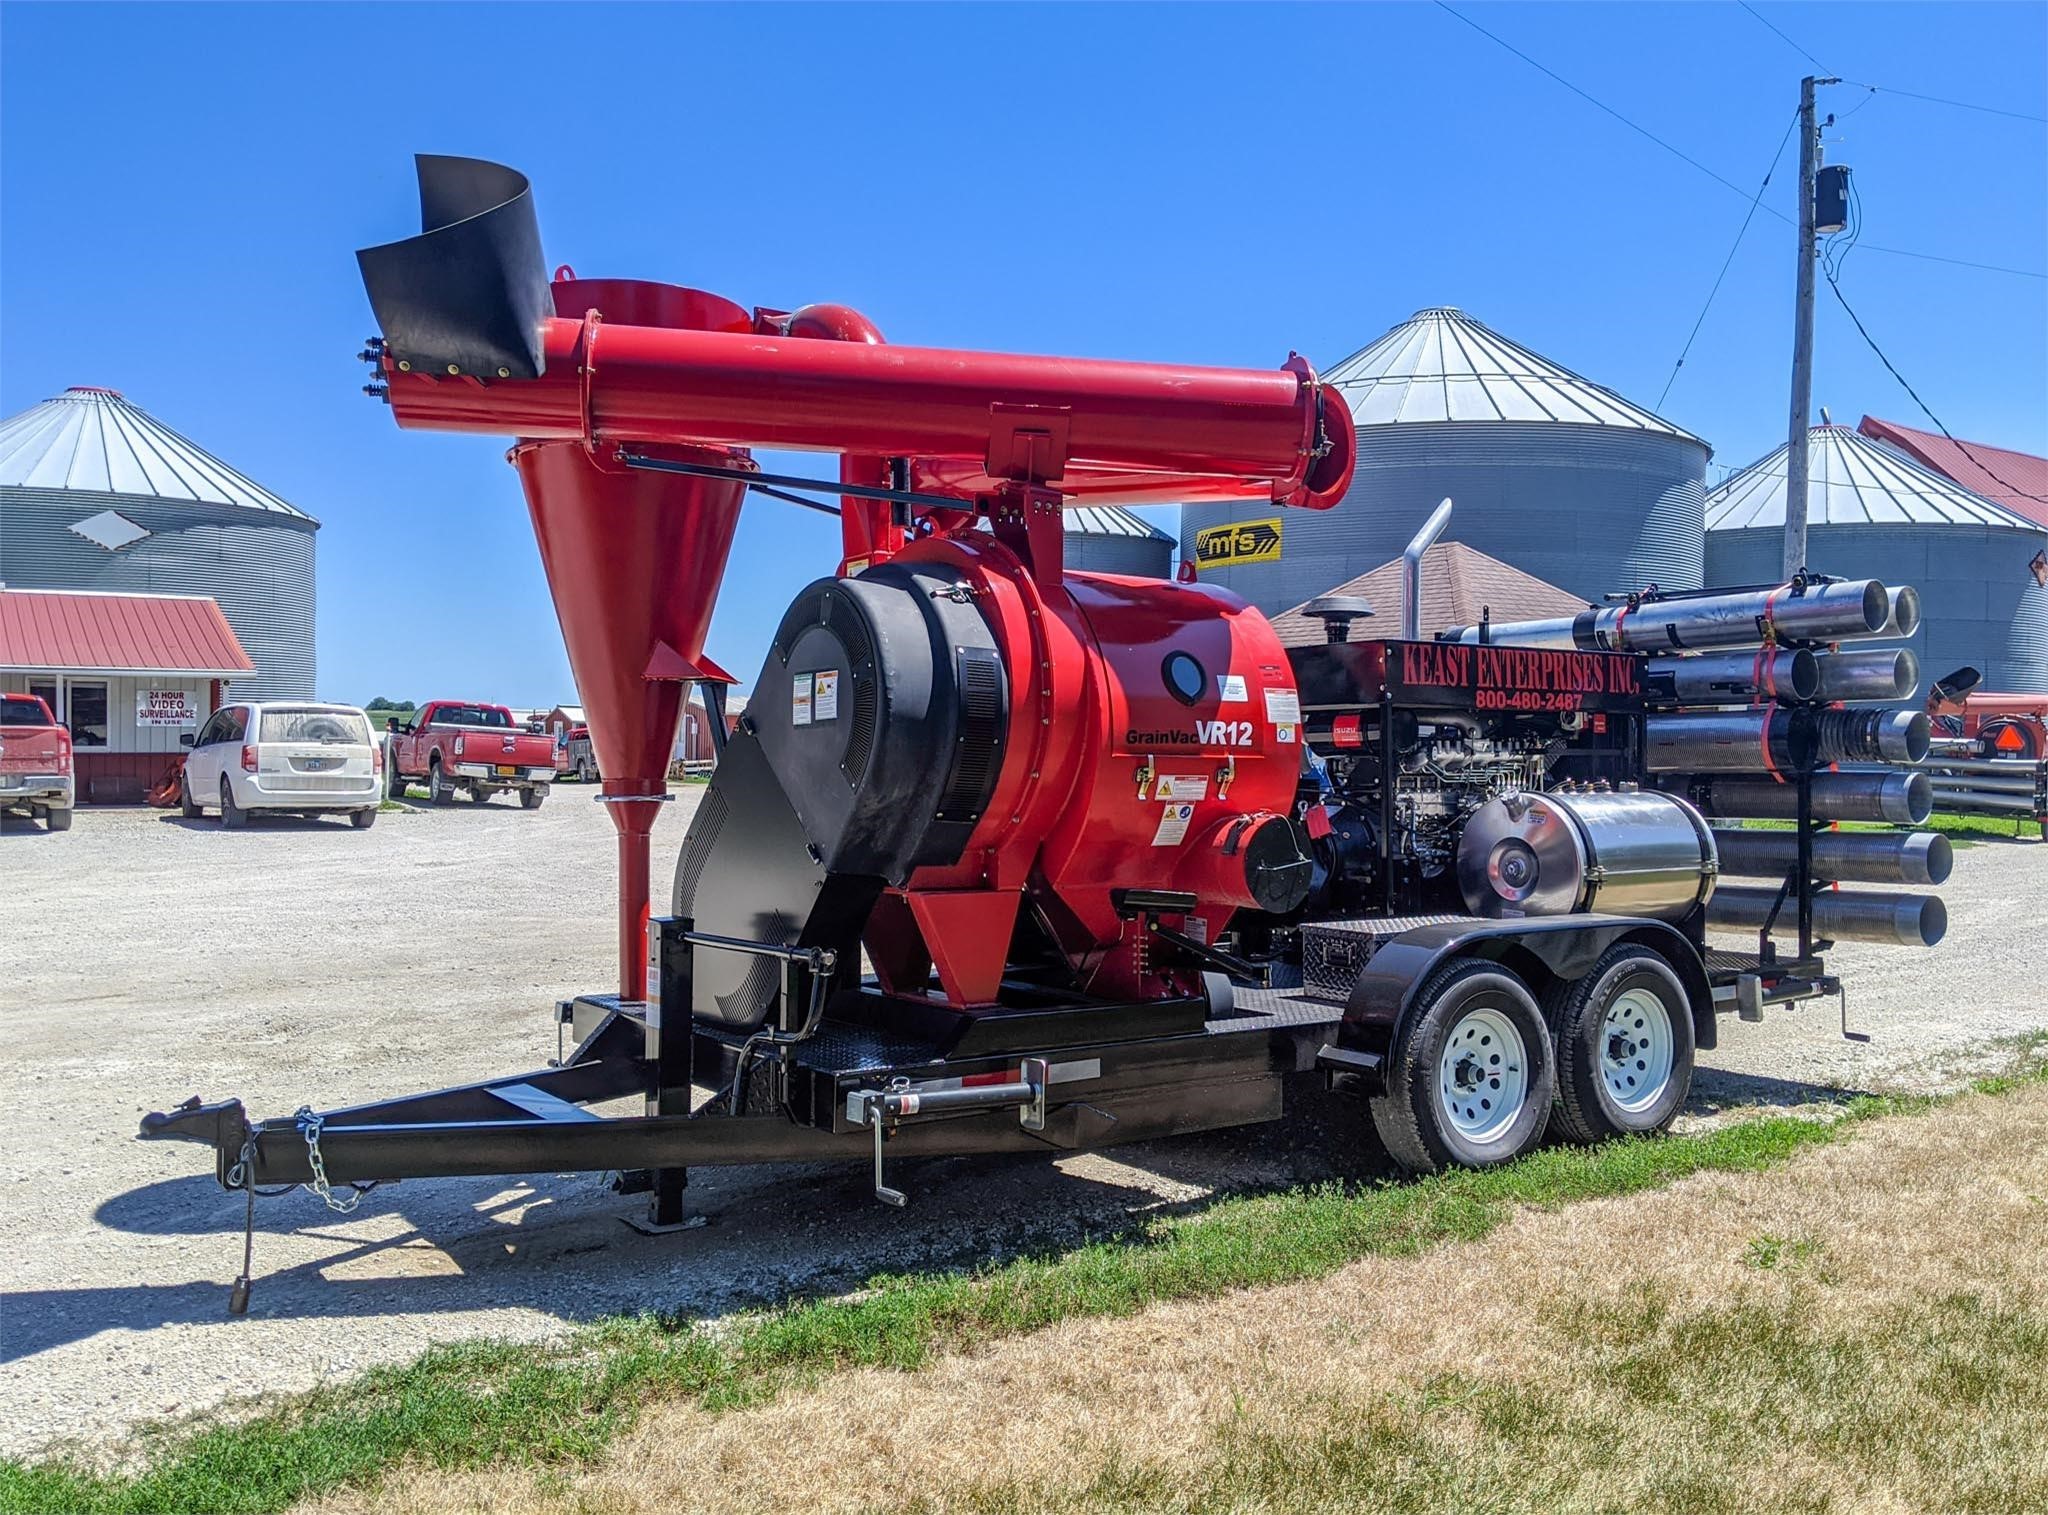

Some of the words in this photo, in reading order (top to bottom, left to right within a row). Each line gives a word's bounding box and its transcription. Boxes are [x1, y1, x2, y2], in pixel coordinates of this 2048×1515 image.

[1208, 528, 1256, 557] mfs
[1402, 644, 1471, 687] KEAST
[1476, 647, 1603, 692] ENTERPRISES
[150, 700, 184, 709] VIDEO
[1475, 690, 1583, 710] 800-480-2487
[139, 709, 194, 718] SURVEILLANCE
[1126, 730, 1199, 744] GrainVac
[1195, 720, 1252, 746] VR12
